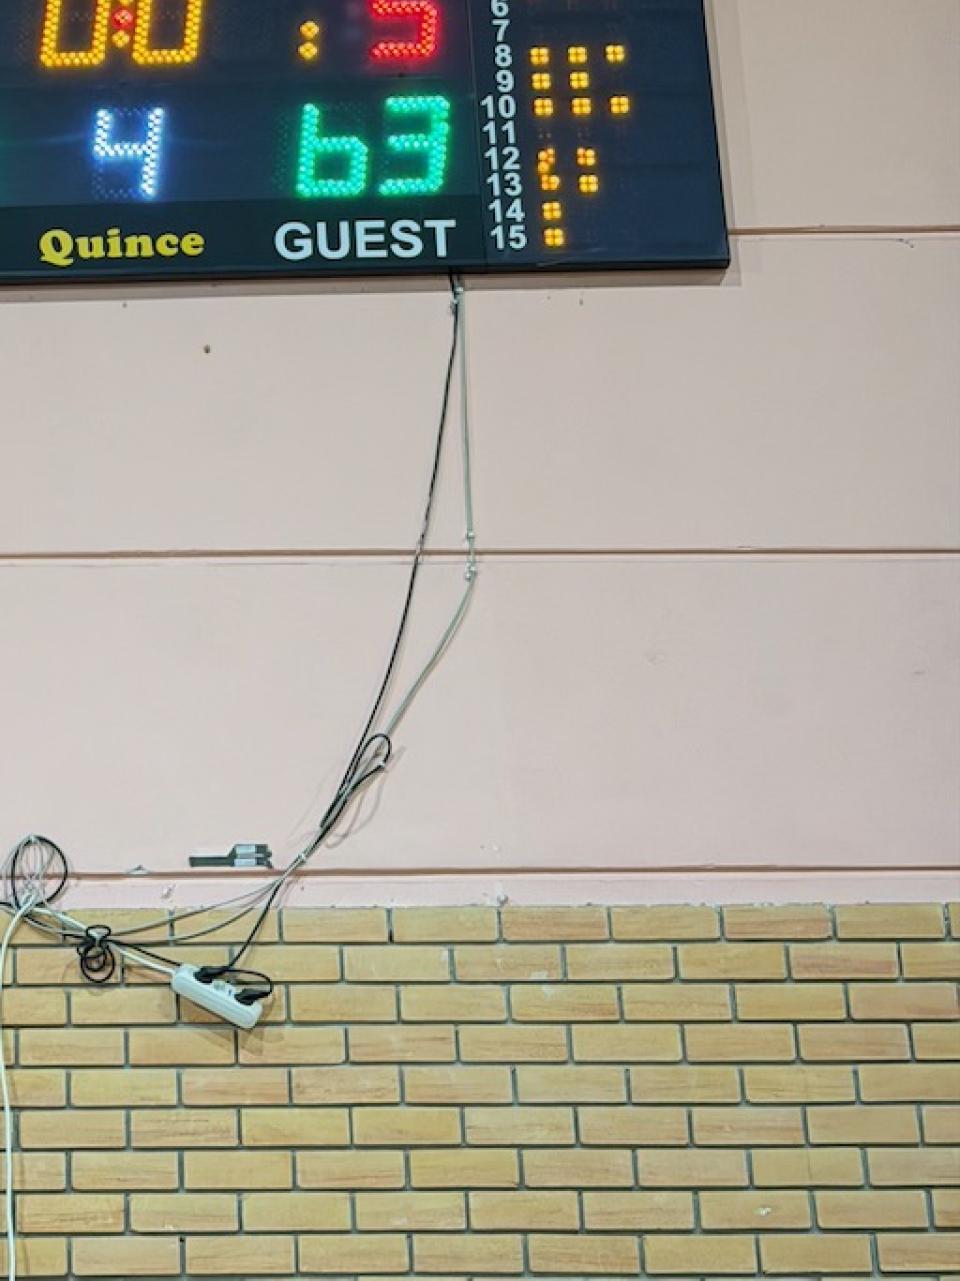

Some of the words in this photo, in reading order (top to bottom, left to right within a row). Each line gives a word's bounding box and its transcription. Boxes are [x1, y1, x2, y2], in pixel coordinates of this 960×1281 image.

[492, 19, 510, 42] 7
[494, 44, 512, 67] 8
[496, 69, 514, 93] 9
[481, 95, 516, 119] 10
[482, 120, 516, 144] 11
[94, 106, 164, 198] 4
[296, 95, 450, 198] 63
[484, 146, 520, 170] 12
[486, 172, 522, 196] 13
[489, 198, 525, 222] 14
[40, 228, 205, 267] Quince
[274, 219, 456, 261] GUEST
[490, 225, 527, 249] 15
